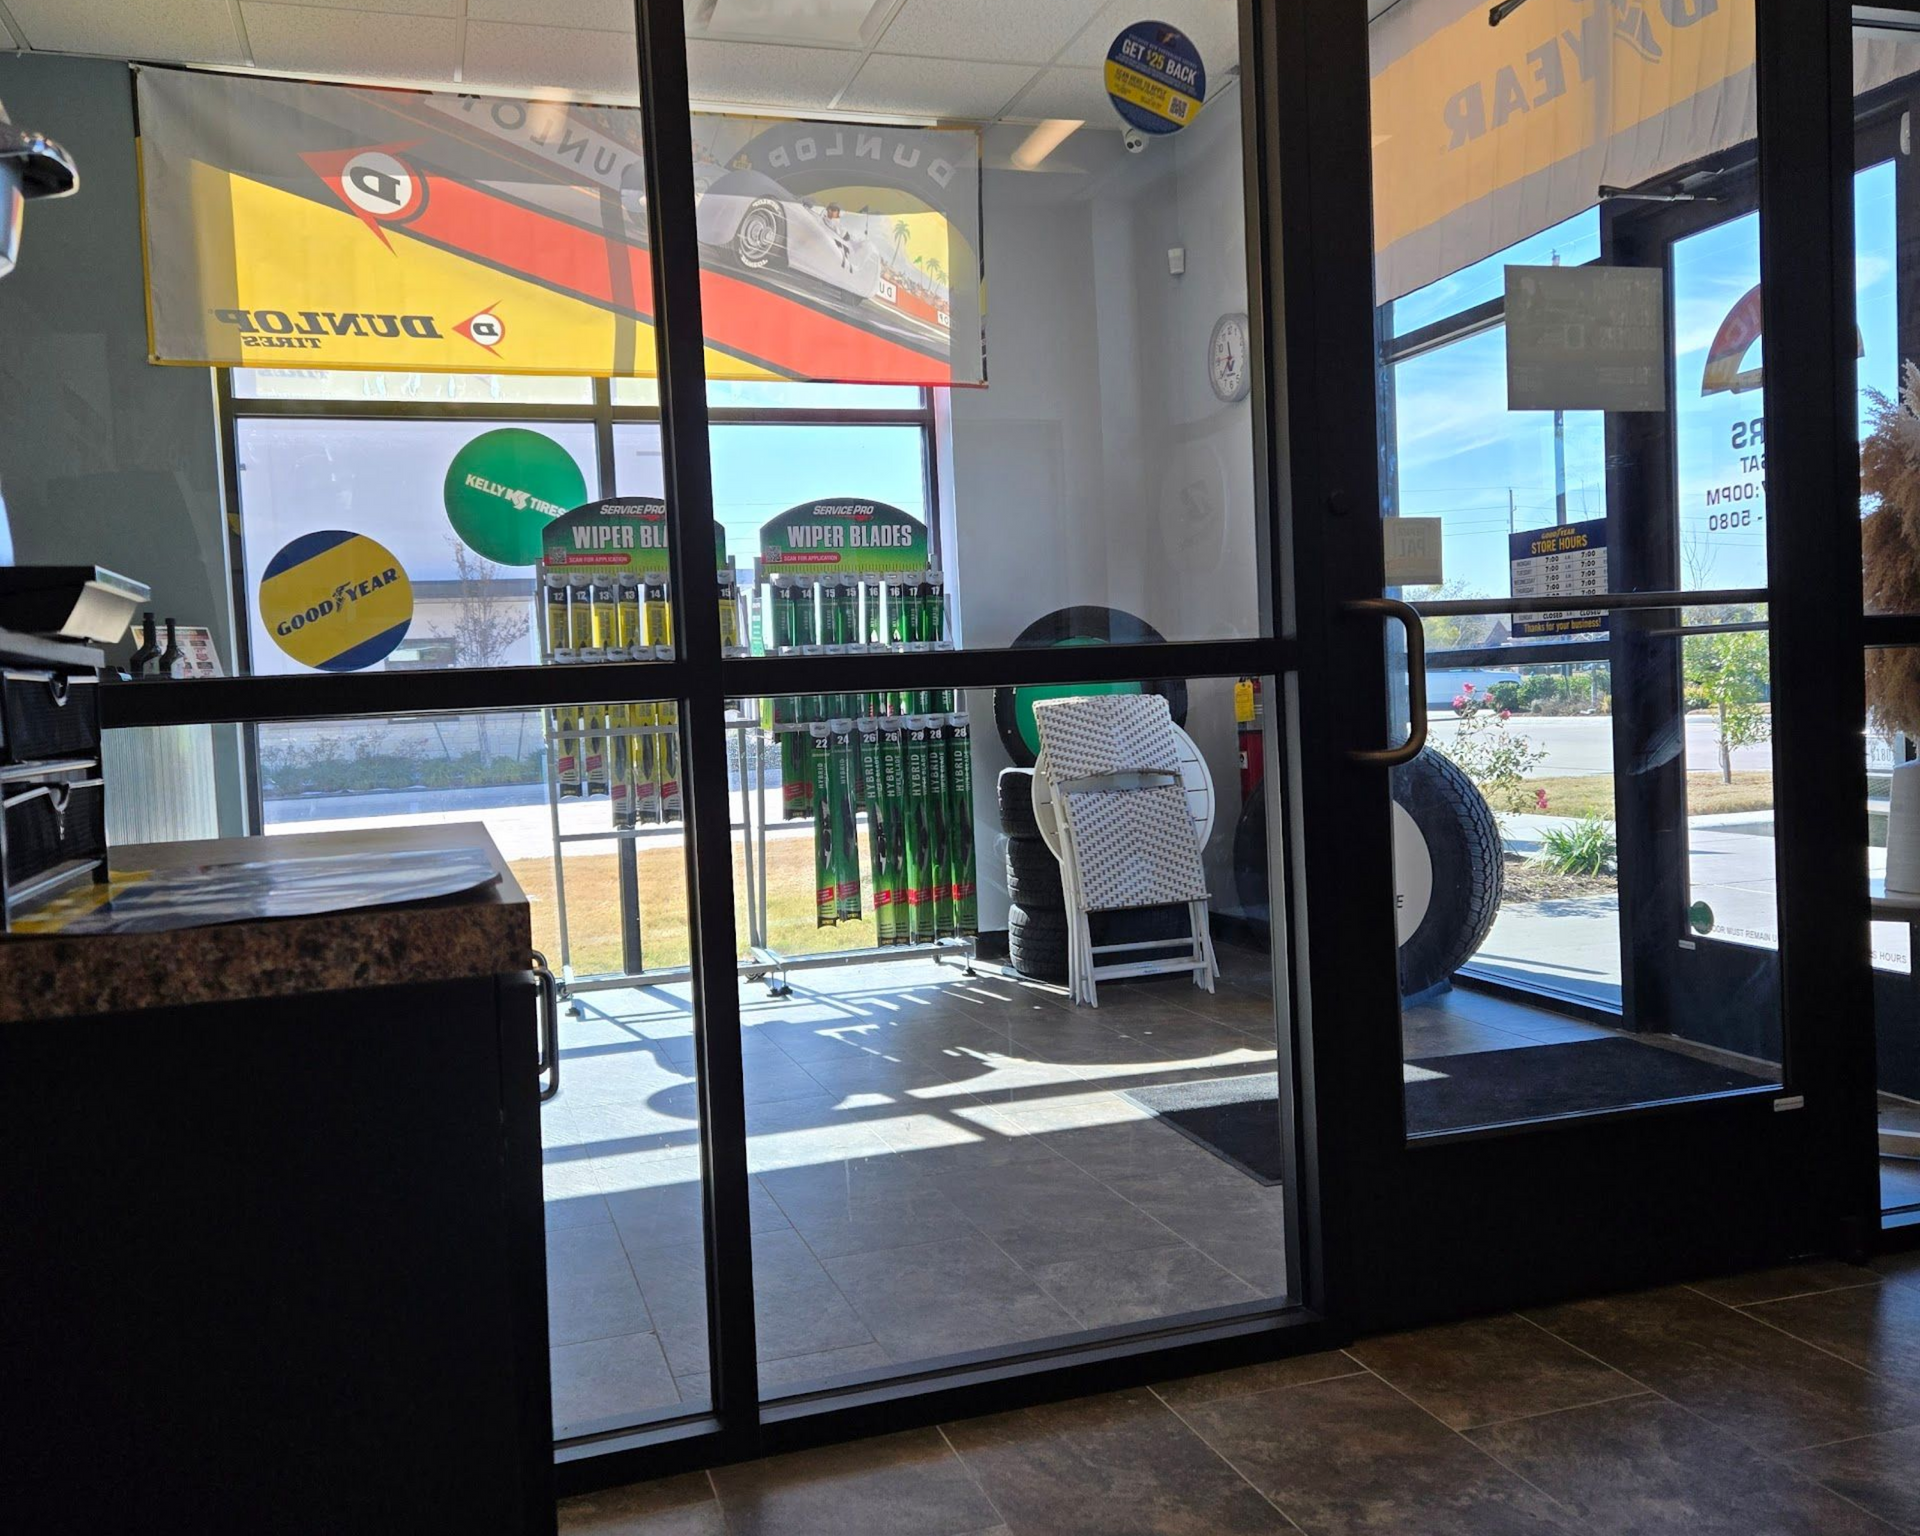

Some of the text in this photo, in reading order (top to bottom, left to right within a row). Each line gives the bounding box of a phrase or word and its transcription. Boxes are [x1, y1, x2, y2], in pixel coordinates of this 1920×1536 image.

[1122, 39, 1146, 60] GET
[1146, 51, 1165, 70] $25
[1166, 60, 1197, 85] BACK
[465, 474, 506, 498] KELLY
[529, 497, 567, 518] TIRES
[572, 526, 634, 549] WIPER
[787, 524, 912, 548] WIPER BLADES
[1531, 535, 1588, 555] STORE HOURS
[1581, 550, 1596, 558] 7:00
[1581, 560, 1596, 568] 7:00
[1545, 574, 1560, 582] 7:00
[1581, 570, 1596, 578] 7:00
[1546, 583, 1560, 591] 7:00
[1581, 578, 1596, 587] 7:00
[554, 591, 564, 600] 12
[576, 590, 587, 600] 12
[599, 591, 610, 600] 13
[624, 590, 635, 600] 13
[650, 589, 661, 598] 14
[779, 590, 790, 599] 14
[802, 590, 812, 598] 14
[1543, 612, 1563, 620] CLOSED
[1524, 617, 1602, 634] Thanks for your business!
[863, 733, 876, 743] 26
[885, 732, 898, 742] 26
[930, 729, 942, 739] 28
[954, 727, 967, 738] 28
[816, 739, 828, 748] 22
[884, 755, 895, 797] HYBRID
[911, 754, 921, 796] HYBRID
[929, 752, 940, 794] HYBRID
[954, 750, 964, 792] HYBRID
[864, 756, 876, 798] HYBRID
[1727, 927, 1744, 937] MUST
[1745, 930, 1771, 941] REMAIN
[1879, 951, 1907, 964] HOURS
